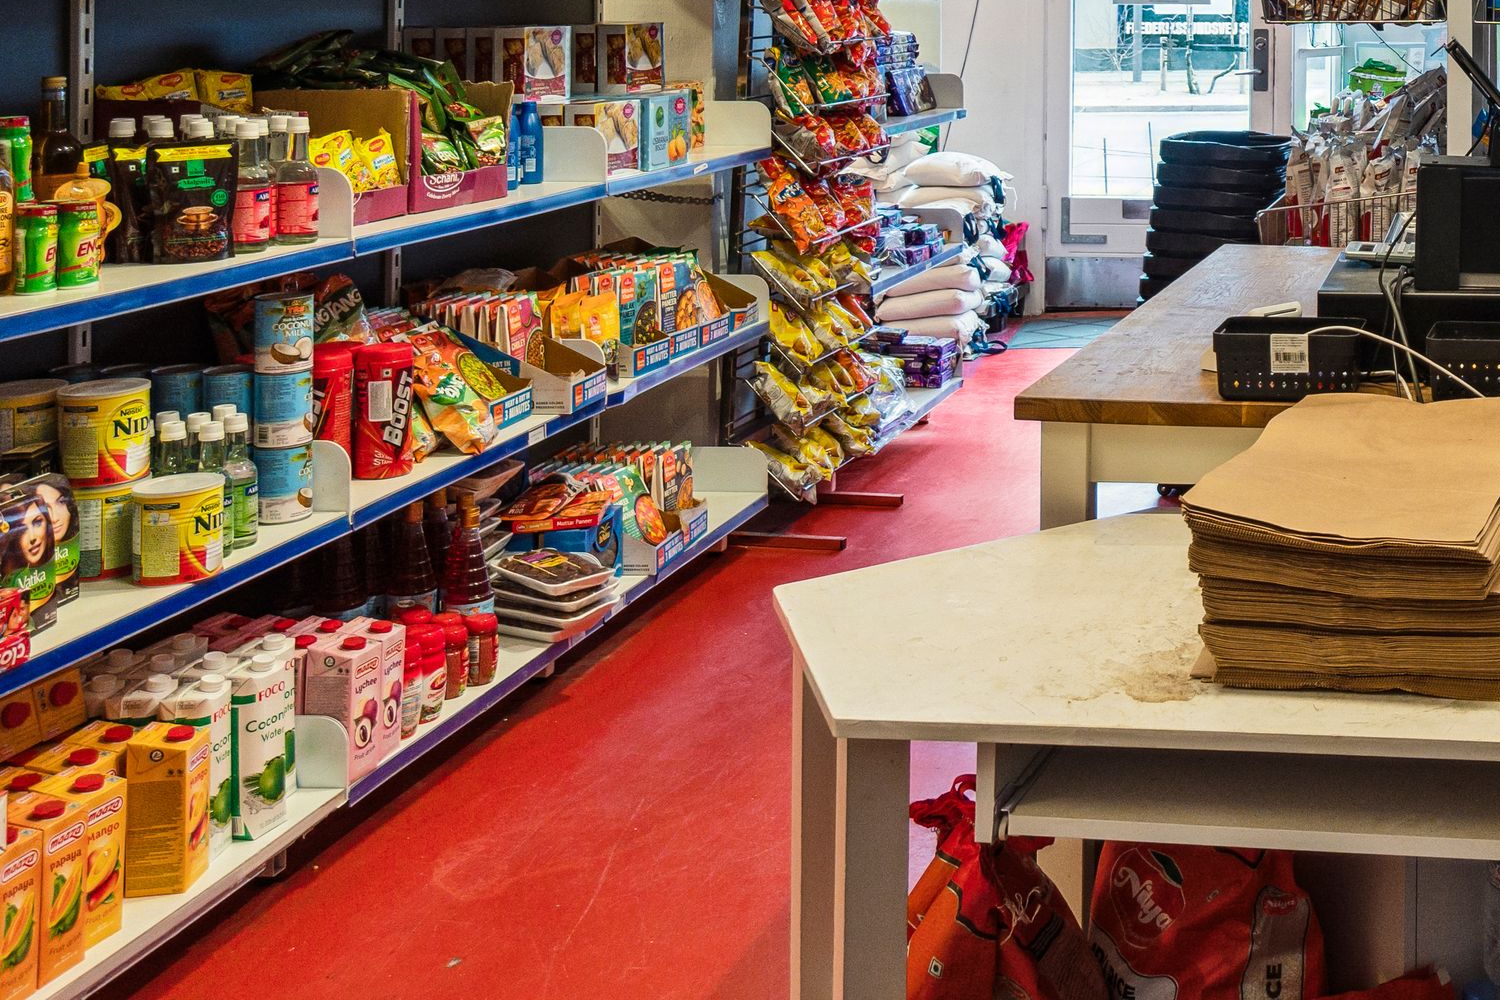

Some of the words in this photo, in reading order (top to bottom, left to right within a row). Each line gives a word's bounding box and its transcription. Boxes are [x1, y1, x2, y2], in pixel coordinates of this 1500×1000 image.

[77, 241, 98, 258] EN
[661, 298, 677, 307] PANEER
[679, 336, 697, 351] MINUTES
[649, 350, 669, 365] MINUTES
[383, 370, 413, 447] BOOST
[508, 401, 531, 420] MINUTES
[113, 416, 149, 439] NID
[575, 516, 593, 525] Paneer
[18, 571, 47, 590] Vatika
[356, 660, 377, 678] maaza
[384, 658, 402, 675] Lychee
[258, 680, 286, 702] FOCO
[355, 677, 378, 695] Lychee
[245, 711, 285, 733] Cocon
[260, 725, 285, 744] Water
[189, 743, 209, 769] maaza
[87, 800, 120, 824] maaza
[50, 824, 83, 852] maaza
[87, 821, 120, 846] Mango
[3, 852, 37, 879] maaza
[1114, 866, 1174, 930] Niya
